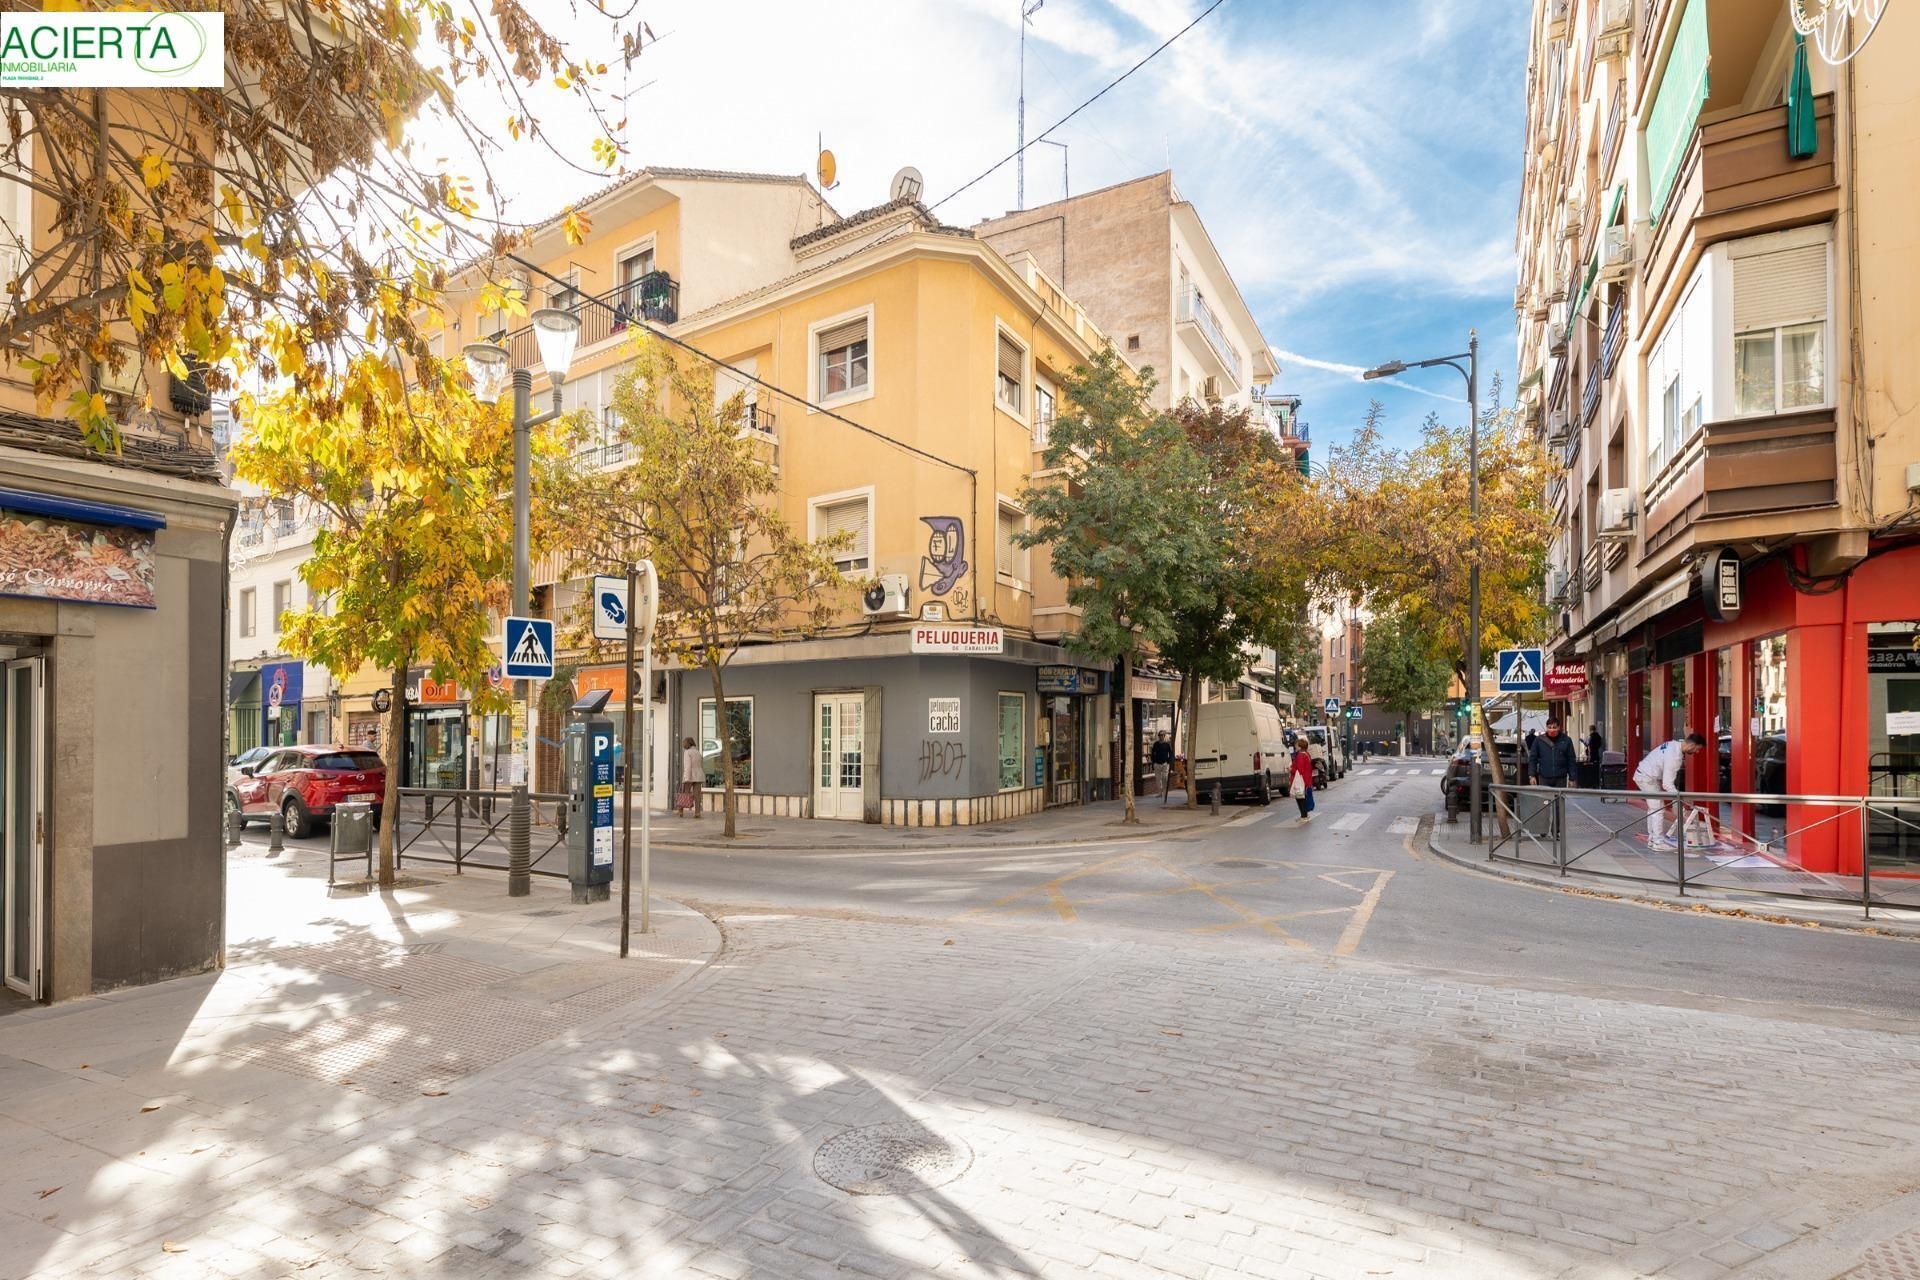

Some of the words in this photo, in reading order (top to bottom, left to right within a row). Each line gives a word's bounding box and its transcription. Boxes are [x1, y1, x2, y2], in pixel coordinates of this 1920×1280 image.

[916, 630, 999, 645] PELUQUERIA
[930, 712, 959, 731] cachá
[594, 735, 609, 757] P
